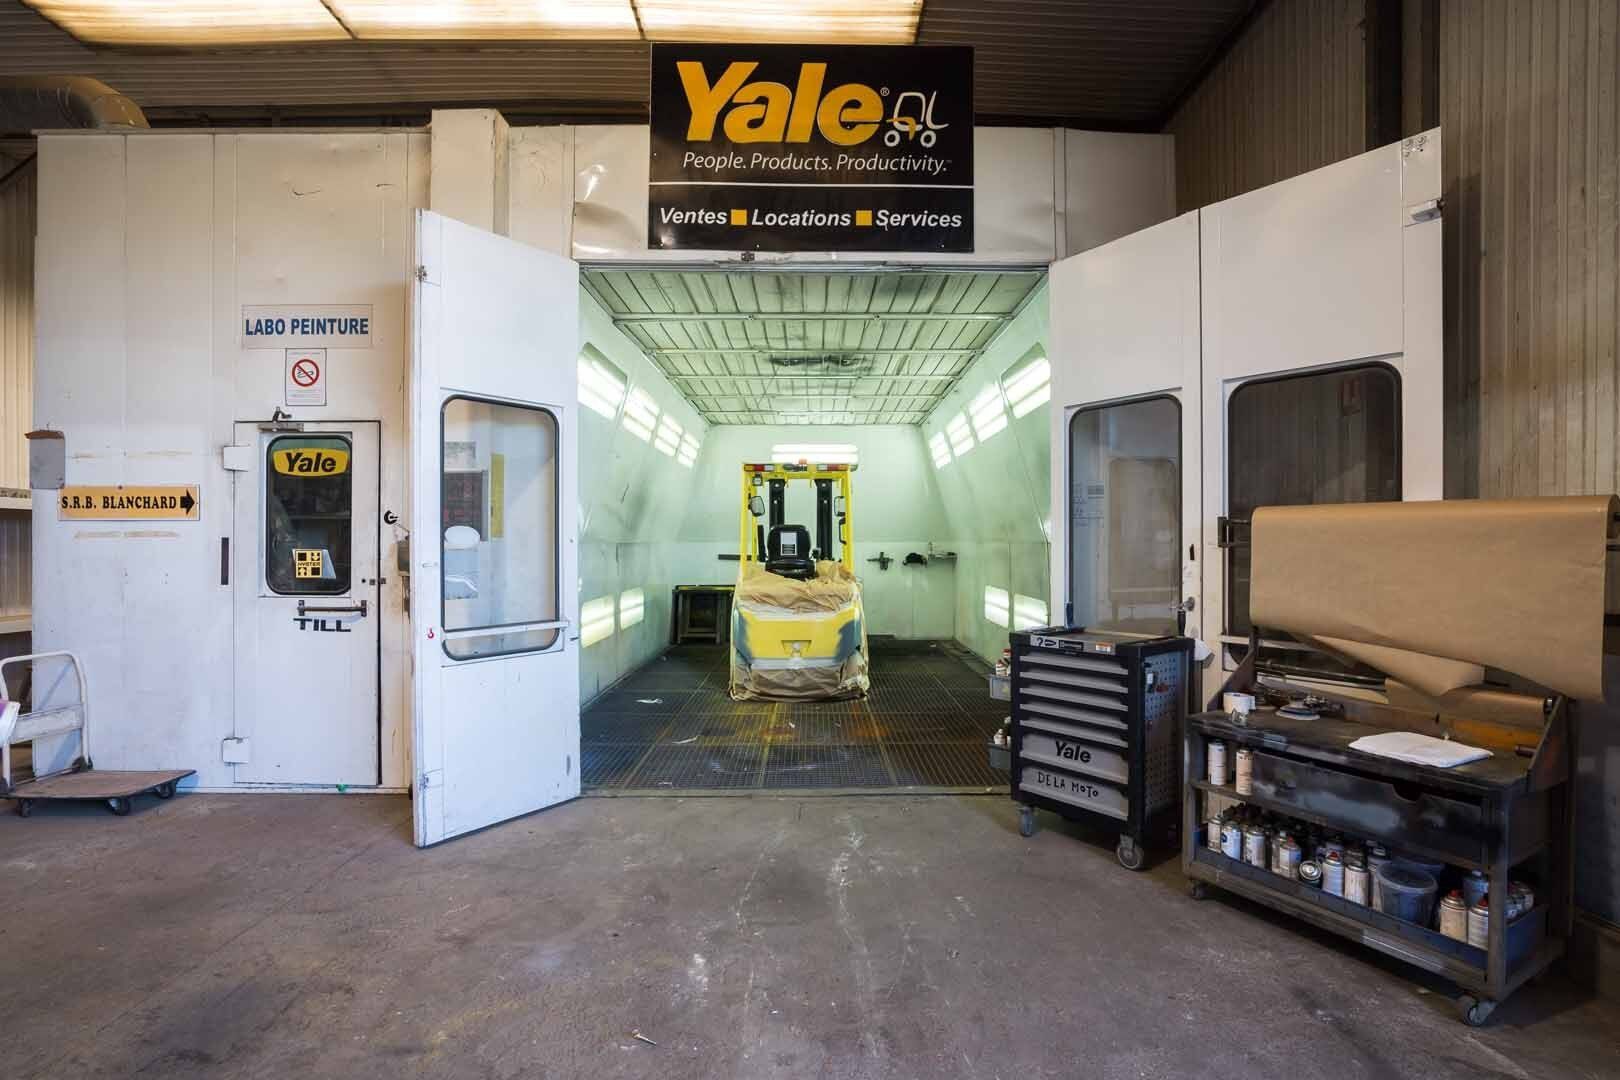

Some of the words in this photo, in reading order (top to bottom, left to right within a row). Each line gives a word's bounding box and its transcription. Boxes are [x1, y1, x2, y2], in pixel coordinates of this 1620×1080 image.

[683, 151, 747, 173] People.
[750, 152, 833, 171] Products.
[836, 153, 947, 175] Productivity.
[660, 207, 728, 226] Ventes
[751, 209, 851, 227] Locations
[875, 209, 962, 228] Services
[245, 318, 286, 336] LABO
[290, 318, 369, 335] PEINTURE
[285, 452, 337, 473] Yale
[61, 495, 97, 509] S.R.B.
[102, 495, 177, 509] BLANCHARD
[293, 617, 351, 632] TILL
[1055, 740, 1091, 763] Yale
